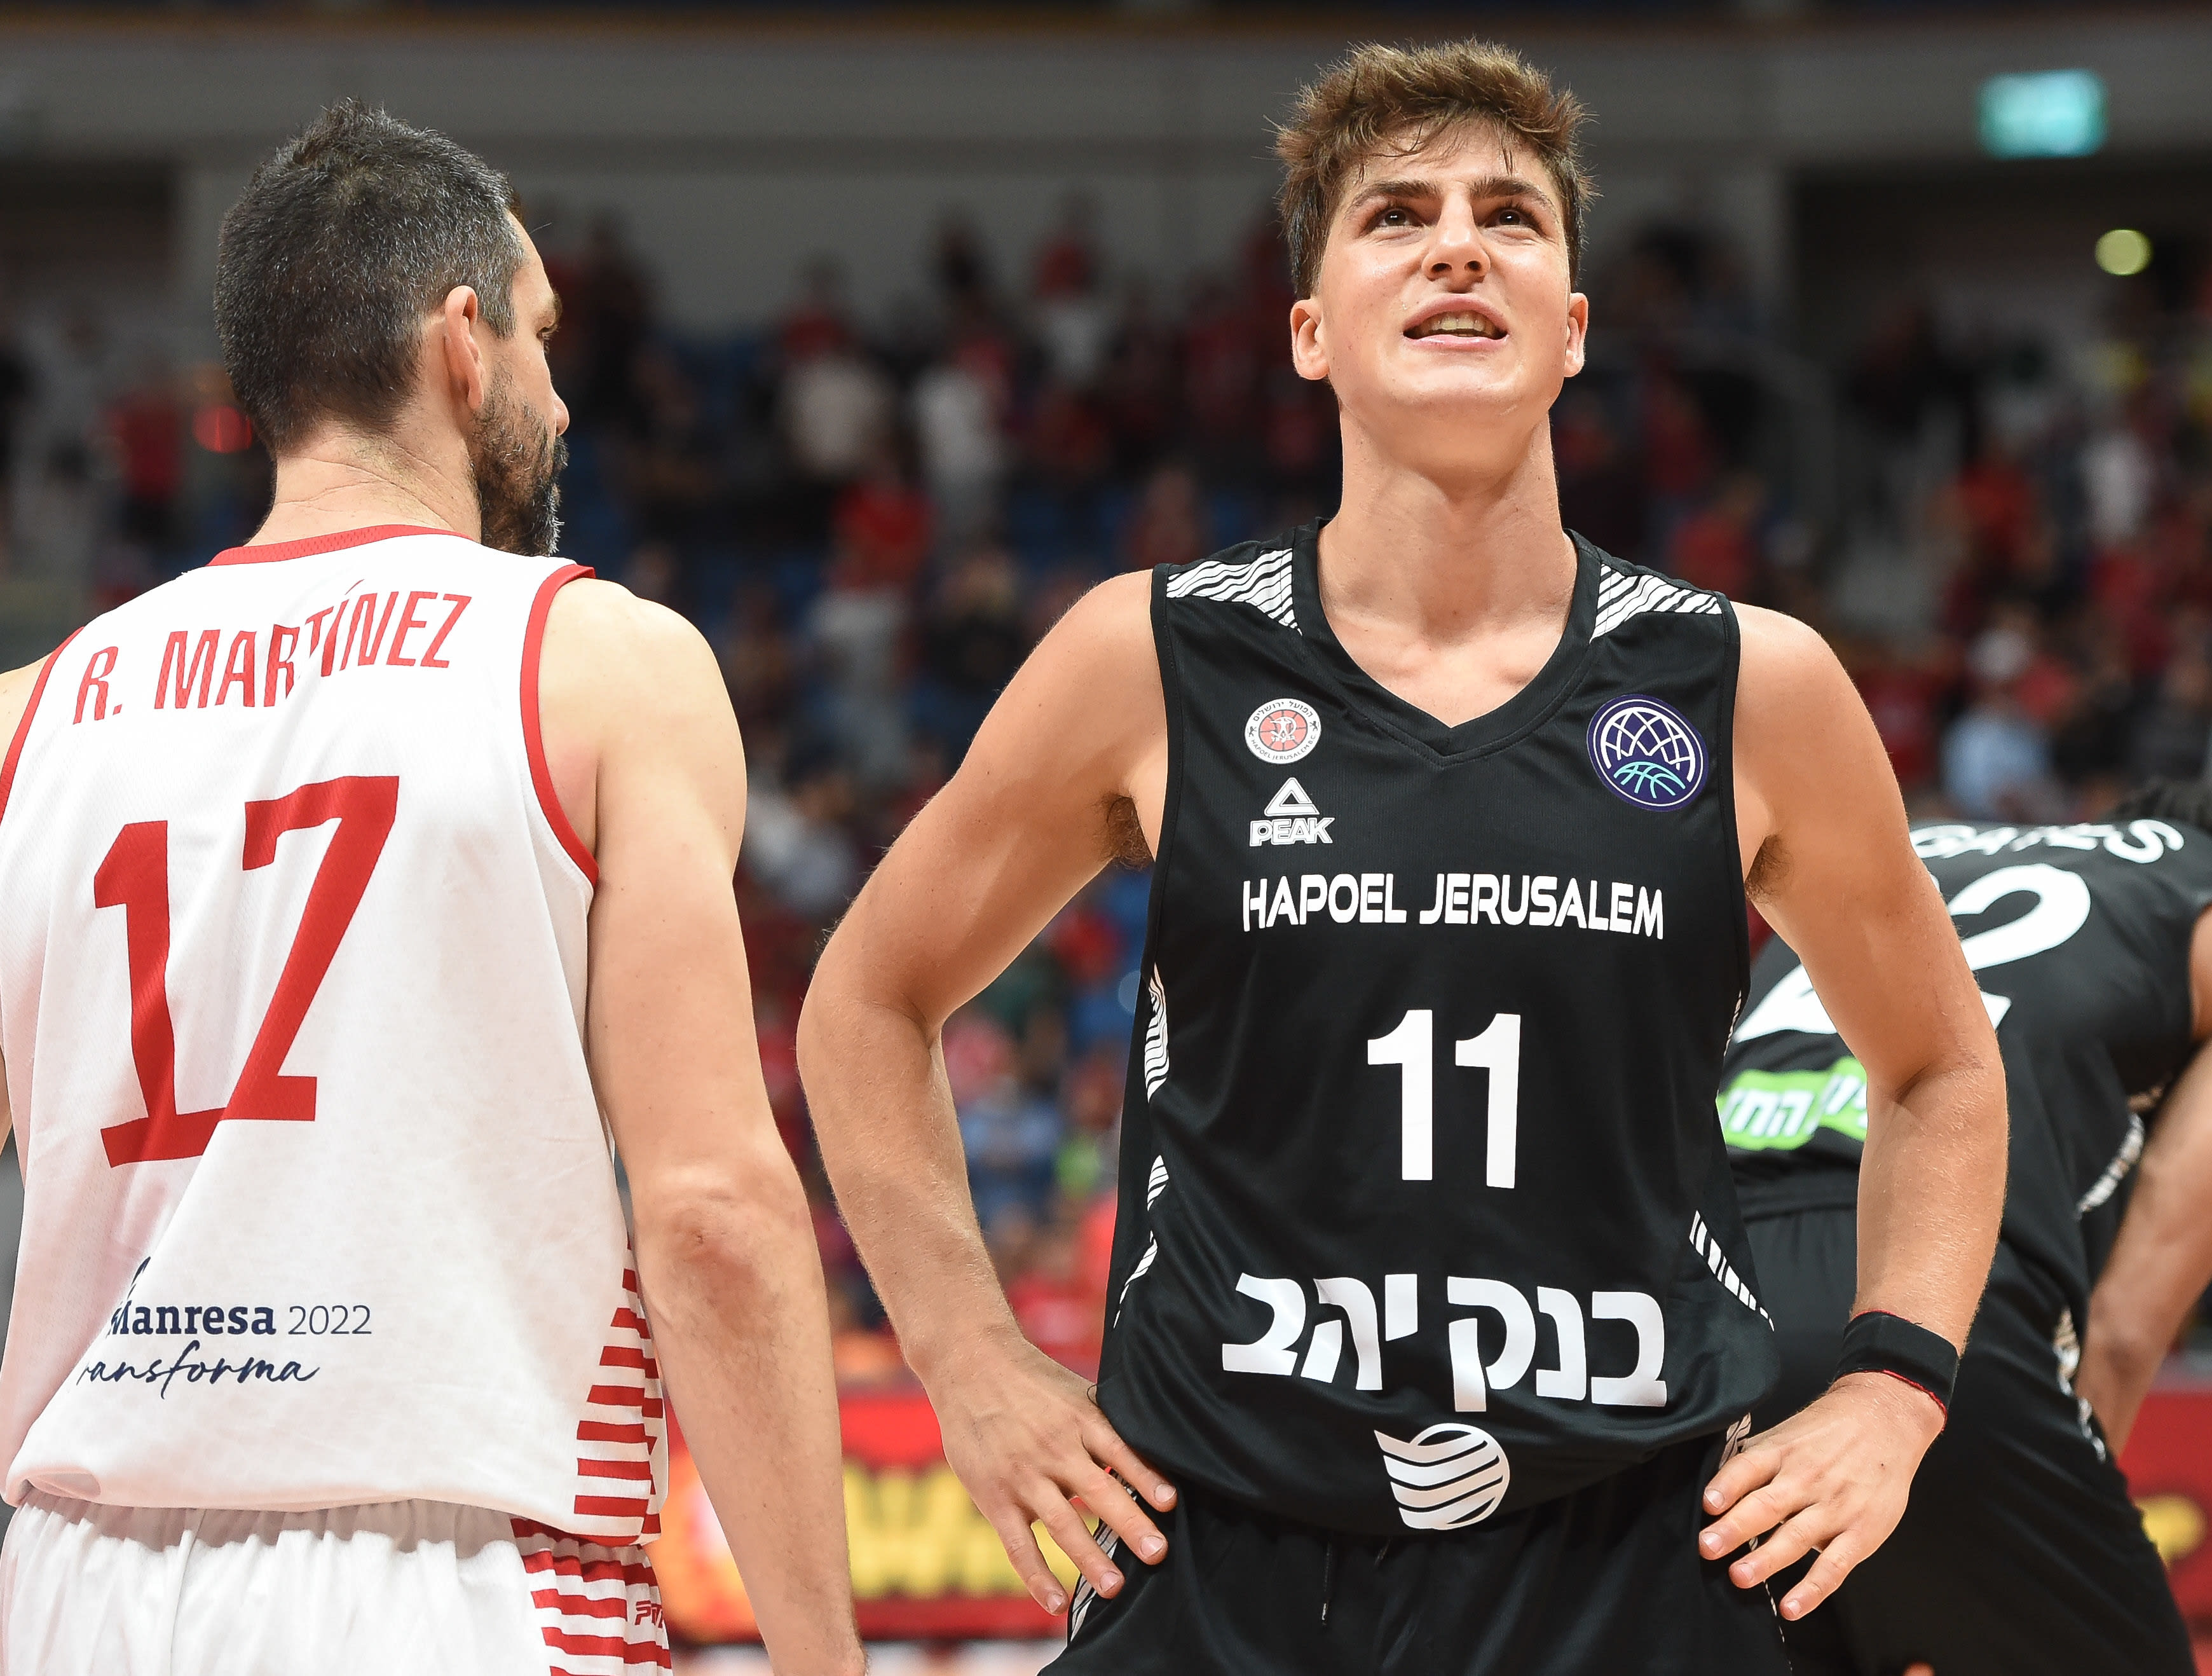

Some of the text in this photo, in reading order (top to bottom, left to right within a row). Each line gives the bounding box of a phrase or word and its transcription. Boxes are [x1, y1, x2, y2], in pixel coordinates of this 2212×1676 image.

[73, 579, 472, 724] R. MARTÍNEZ
[1251, 739, 1271, 759] HAPOEL
[1272, 745, 1310, 760] JERUSALEM
[1250, 818, 1335, 846] PEAK
[1243, 873, 1663, 940] HAPOEL JERUSALEM
[94, 776, 399, 1169] 17
[1367, 1009, 1521, 1189] 11
[288, 1305, 372, 1335] 2022
[1222, 1272, 1667, 1412] בנק יהב
